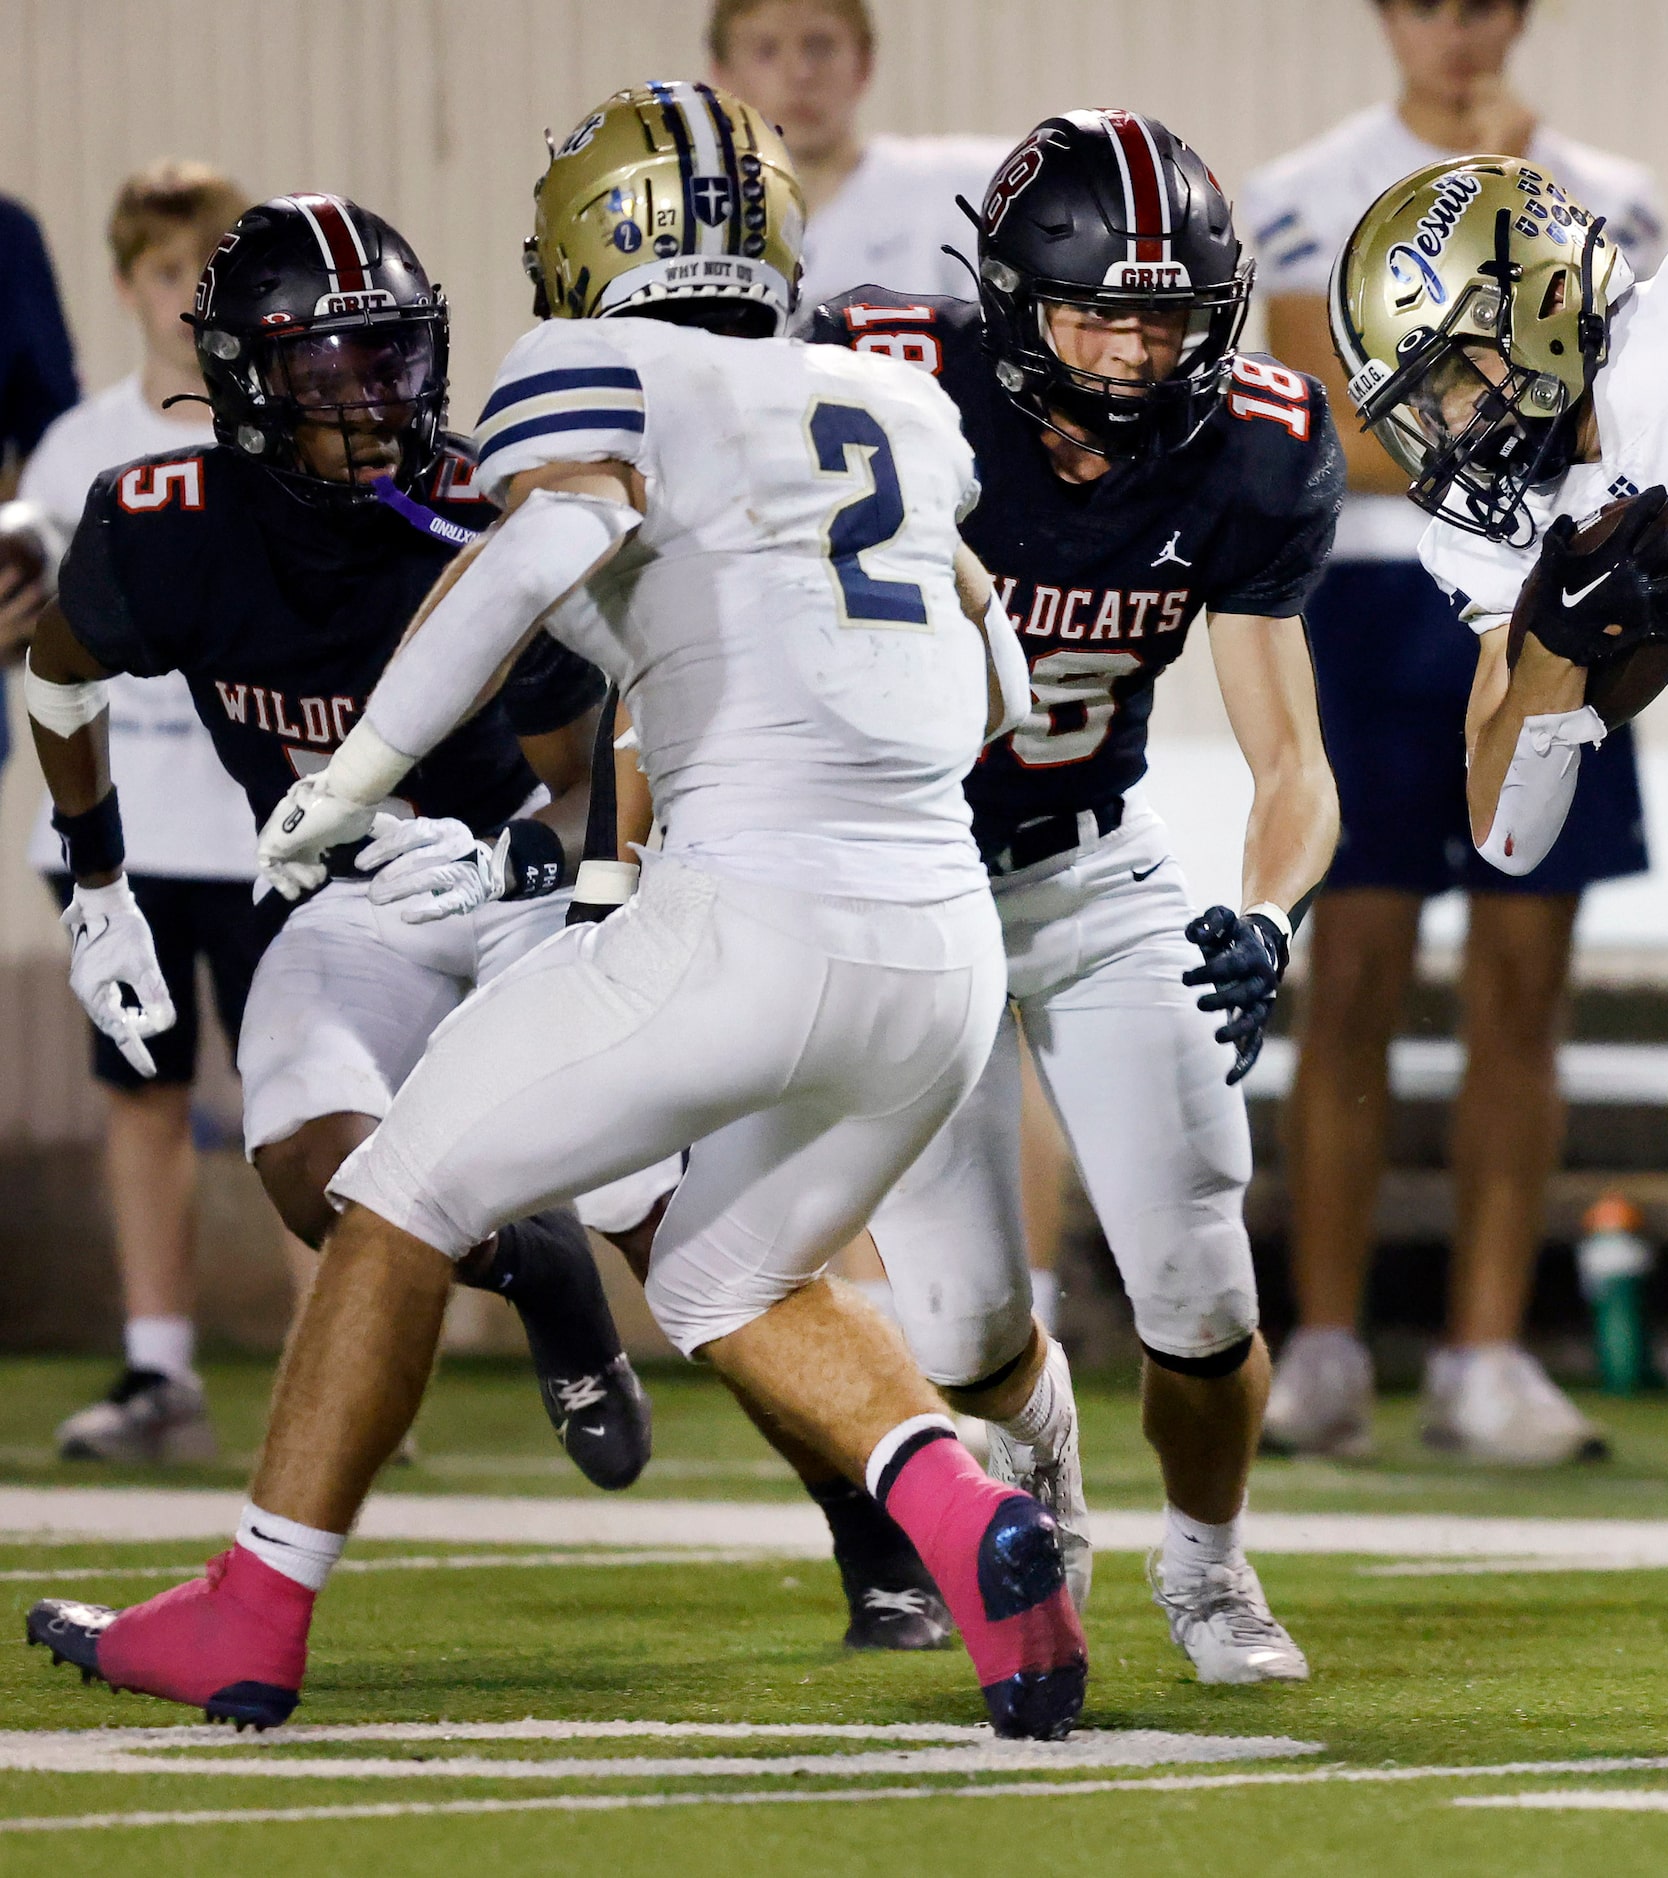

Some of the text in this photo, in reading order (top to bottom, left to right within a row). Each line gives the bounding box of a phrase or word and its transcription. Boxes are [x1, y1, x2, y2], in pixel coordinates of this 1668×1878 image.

[657, 209, 677, 228] 27
[1386, 170, 1484, 306] Jesuit
[328, 294, 388, 315] GRIT
[665, 261, 754, 283] WHY NOT US
[1121, 268, 1182, 290] GRIT
[1230, 353, 1309, 442] 18
[117, 456, 207, 514] 5
[802, 392, 936, 635] 2
[990, 573, 1190, 641] LDCATS
[213, 677, 370, 744] WILDC
[1006, 648, 1146, 770] 8
